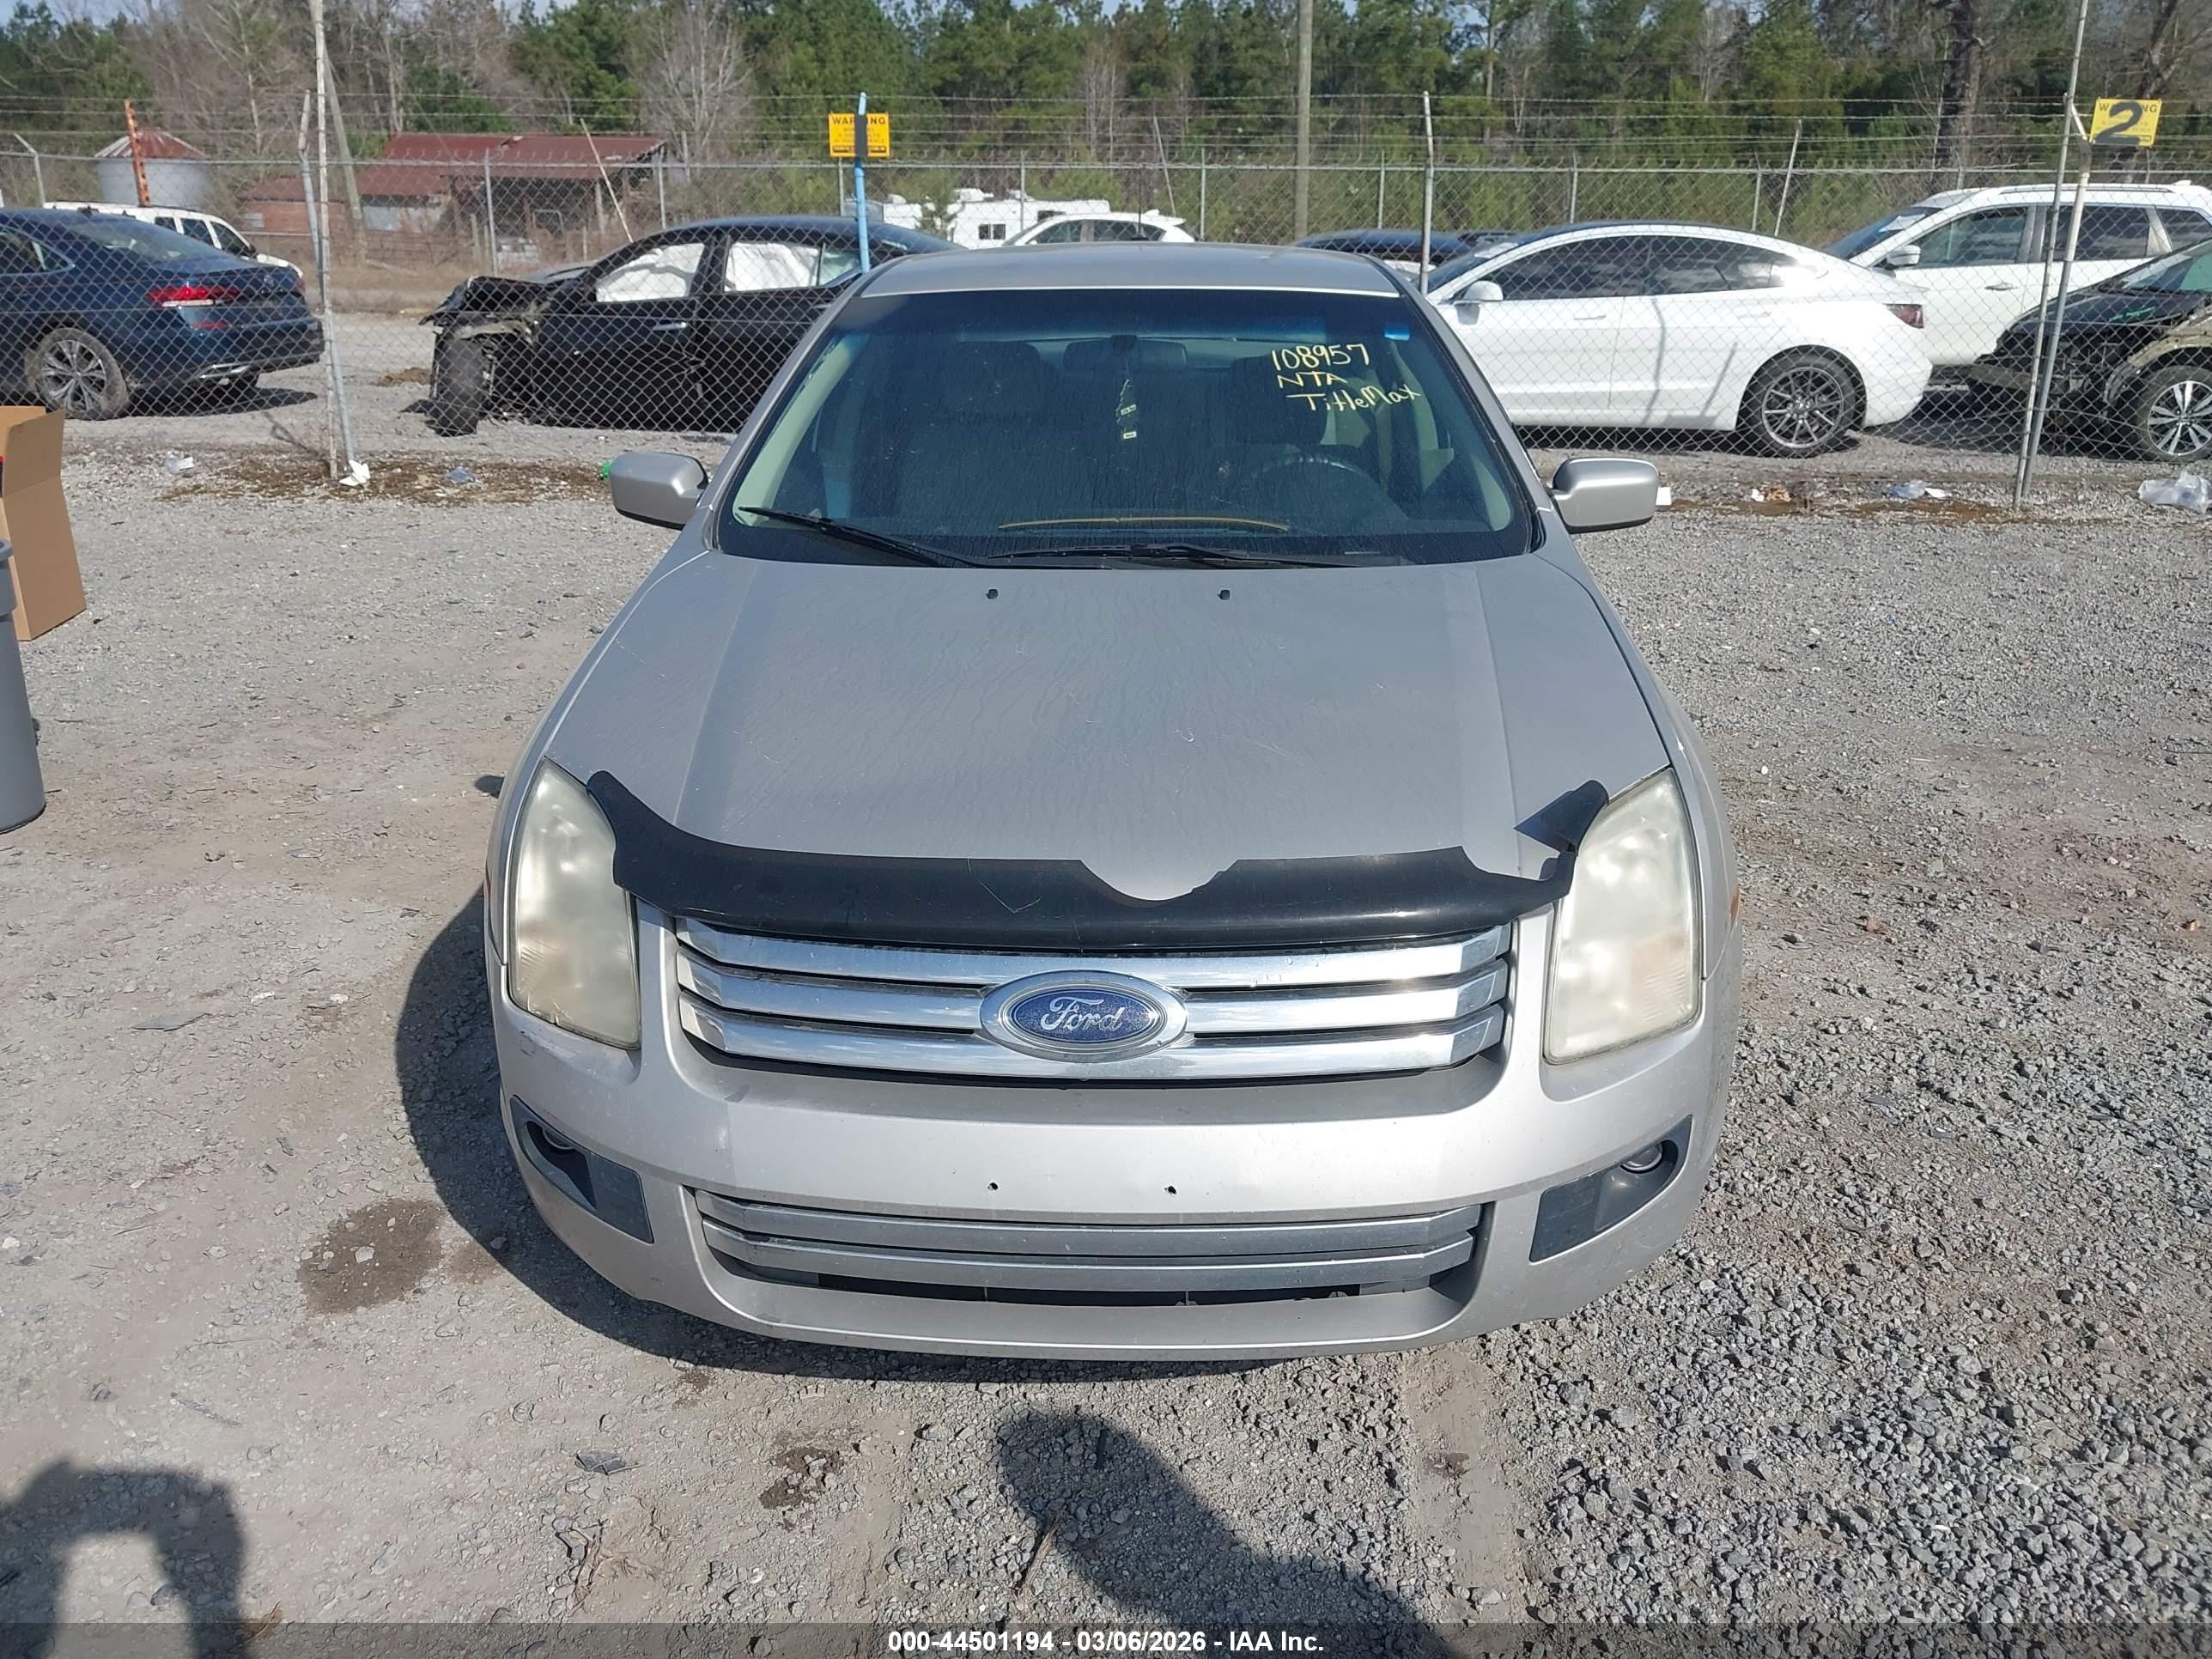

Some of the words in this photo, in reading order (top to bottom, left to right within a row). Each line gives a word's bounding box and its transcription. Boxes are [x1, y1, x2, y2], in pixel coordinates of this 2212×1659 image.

[2096, 101, 2142, 145] 2
[1272, 343, 1370, 371] 108957
[1277, 371, 1348, 389] NTA
[1285, 383, 1422, 412] TitleMax
[1041, 996, 1127, 1031] Ford
